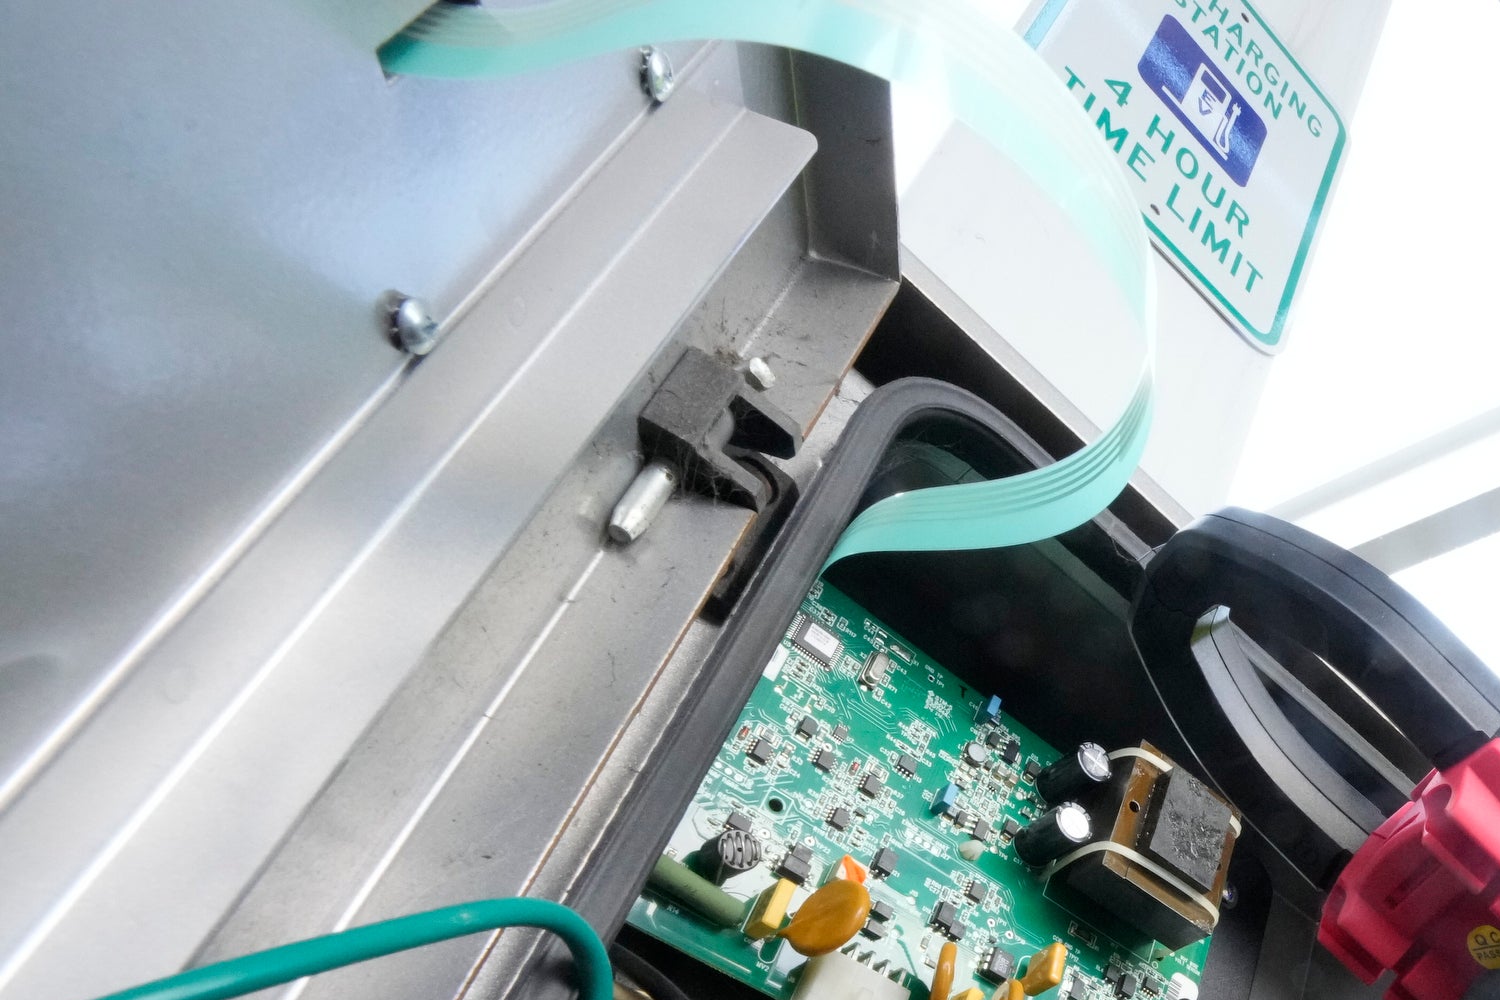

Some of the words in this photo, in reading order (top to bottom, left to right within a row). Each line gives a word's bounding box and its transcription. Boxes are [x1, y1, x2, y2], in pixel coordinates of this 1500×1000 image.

[1207, 0, 1323, 138] HARGING
[1064, 65, 1156, 183] TIME
[1165, 182, 1264, 294] LIMIT
[1103, 78, 1133, 108] 4
[1145, 113, 1250, 240] HOUR
